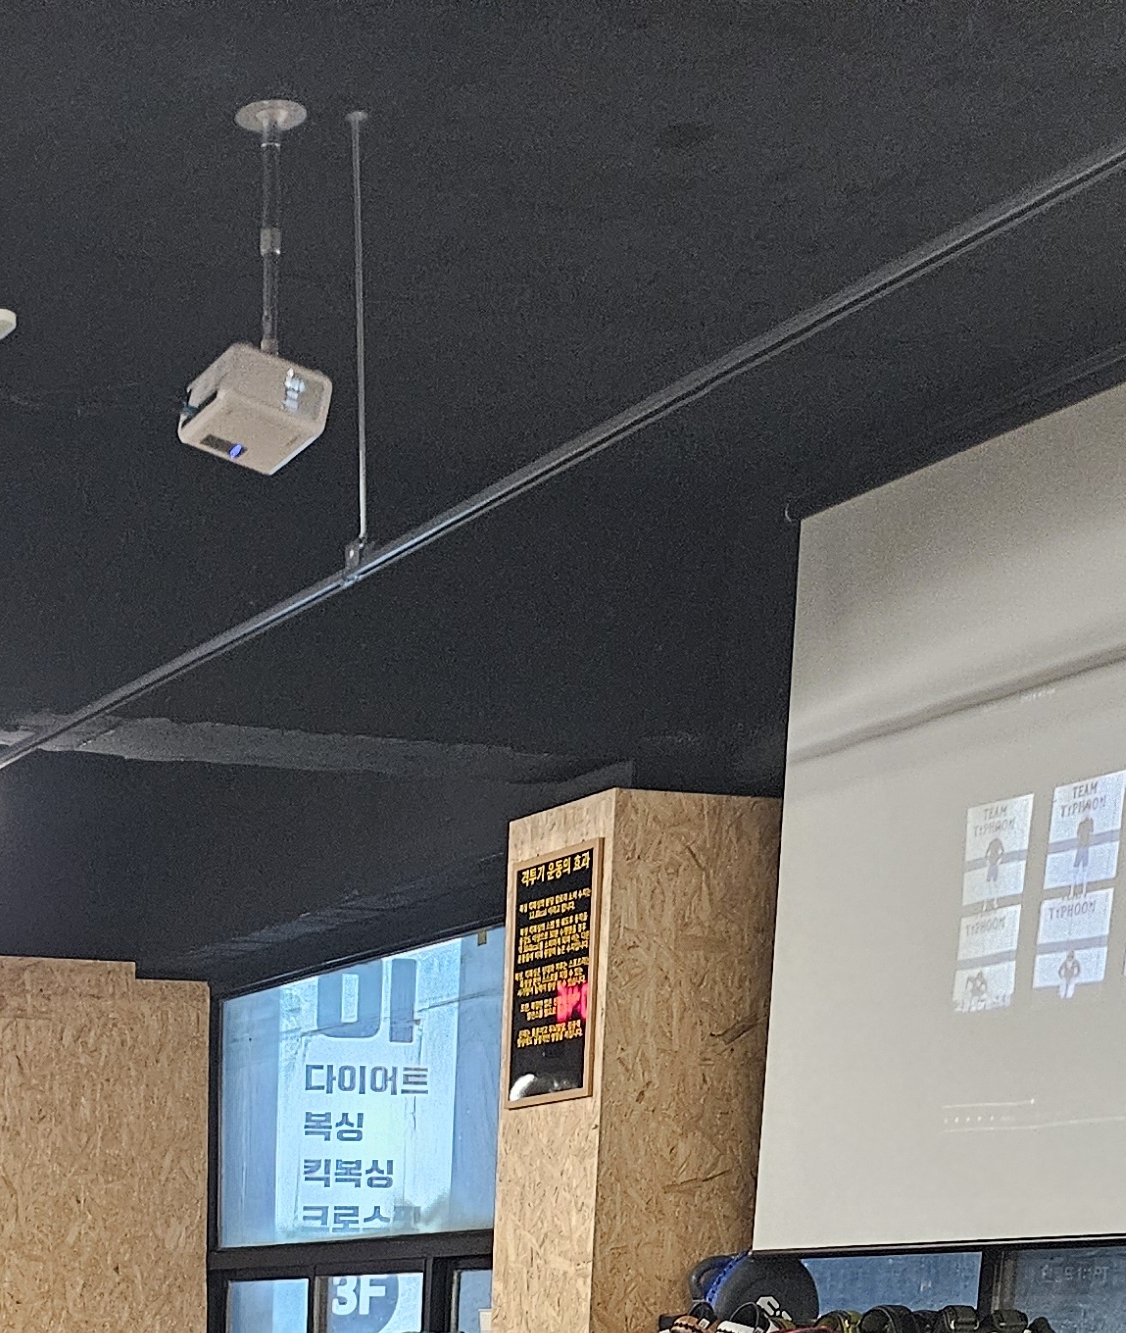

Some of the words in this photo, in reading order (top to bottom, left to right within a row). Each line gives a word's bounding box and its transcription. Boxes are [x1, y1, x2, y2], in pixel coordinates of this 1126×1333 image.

[1073, 782, 1098, 799] TEAM
[984, 806, 1008, 821] TEAM
[521, 866, 545, 886] 격투기
[547, 858, 571, 880] 운동의
[574, 852, 591, 870] 효과
[305, 1063, 430, 1095] 다이어트
[304, 1112, 364, 1142] 복싱
[303, 1158, 394, 1189] 킥복싱
[332, 1276, 386, 1315] 3F
